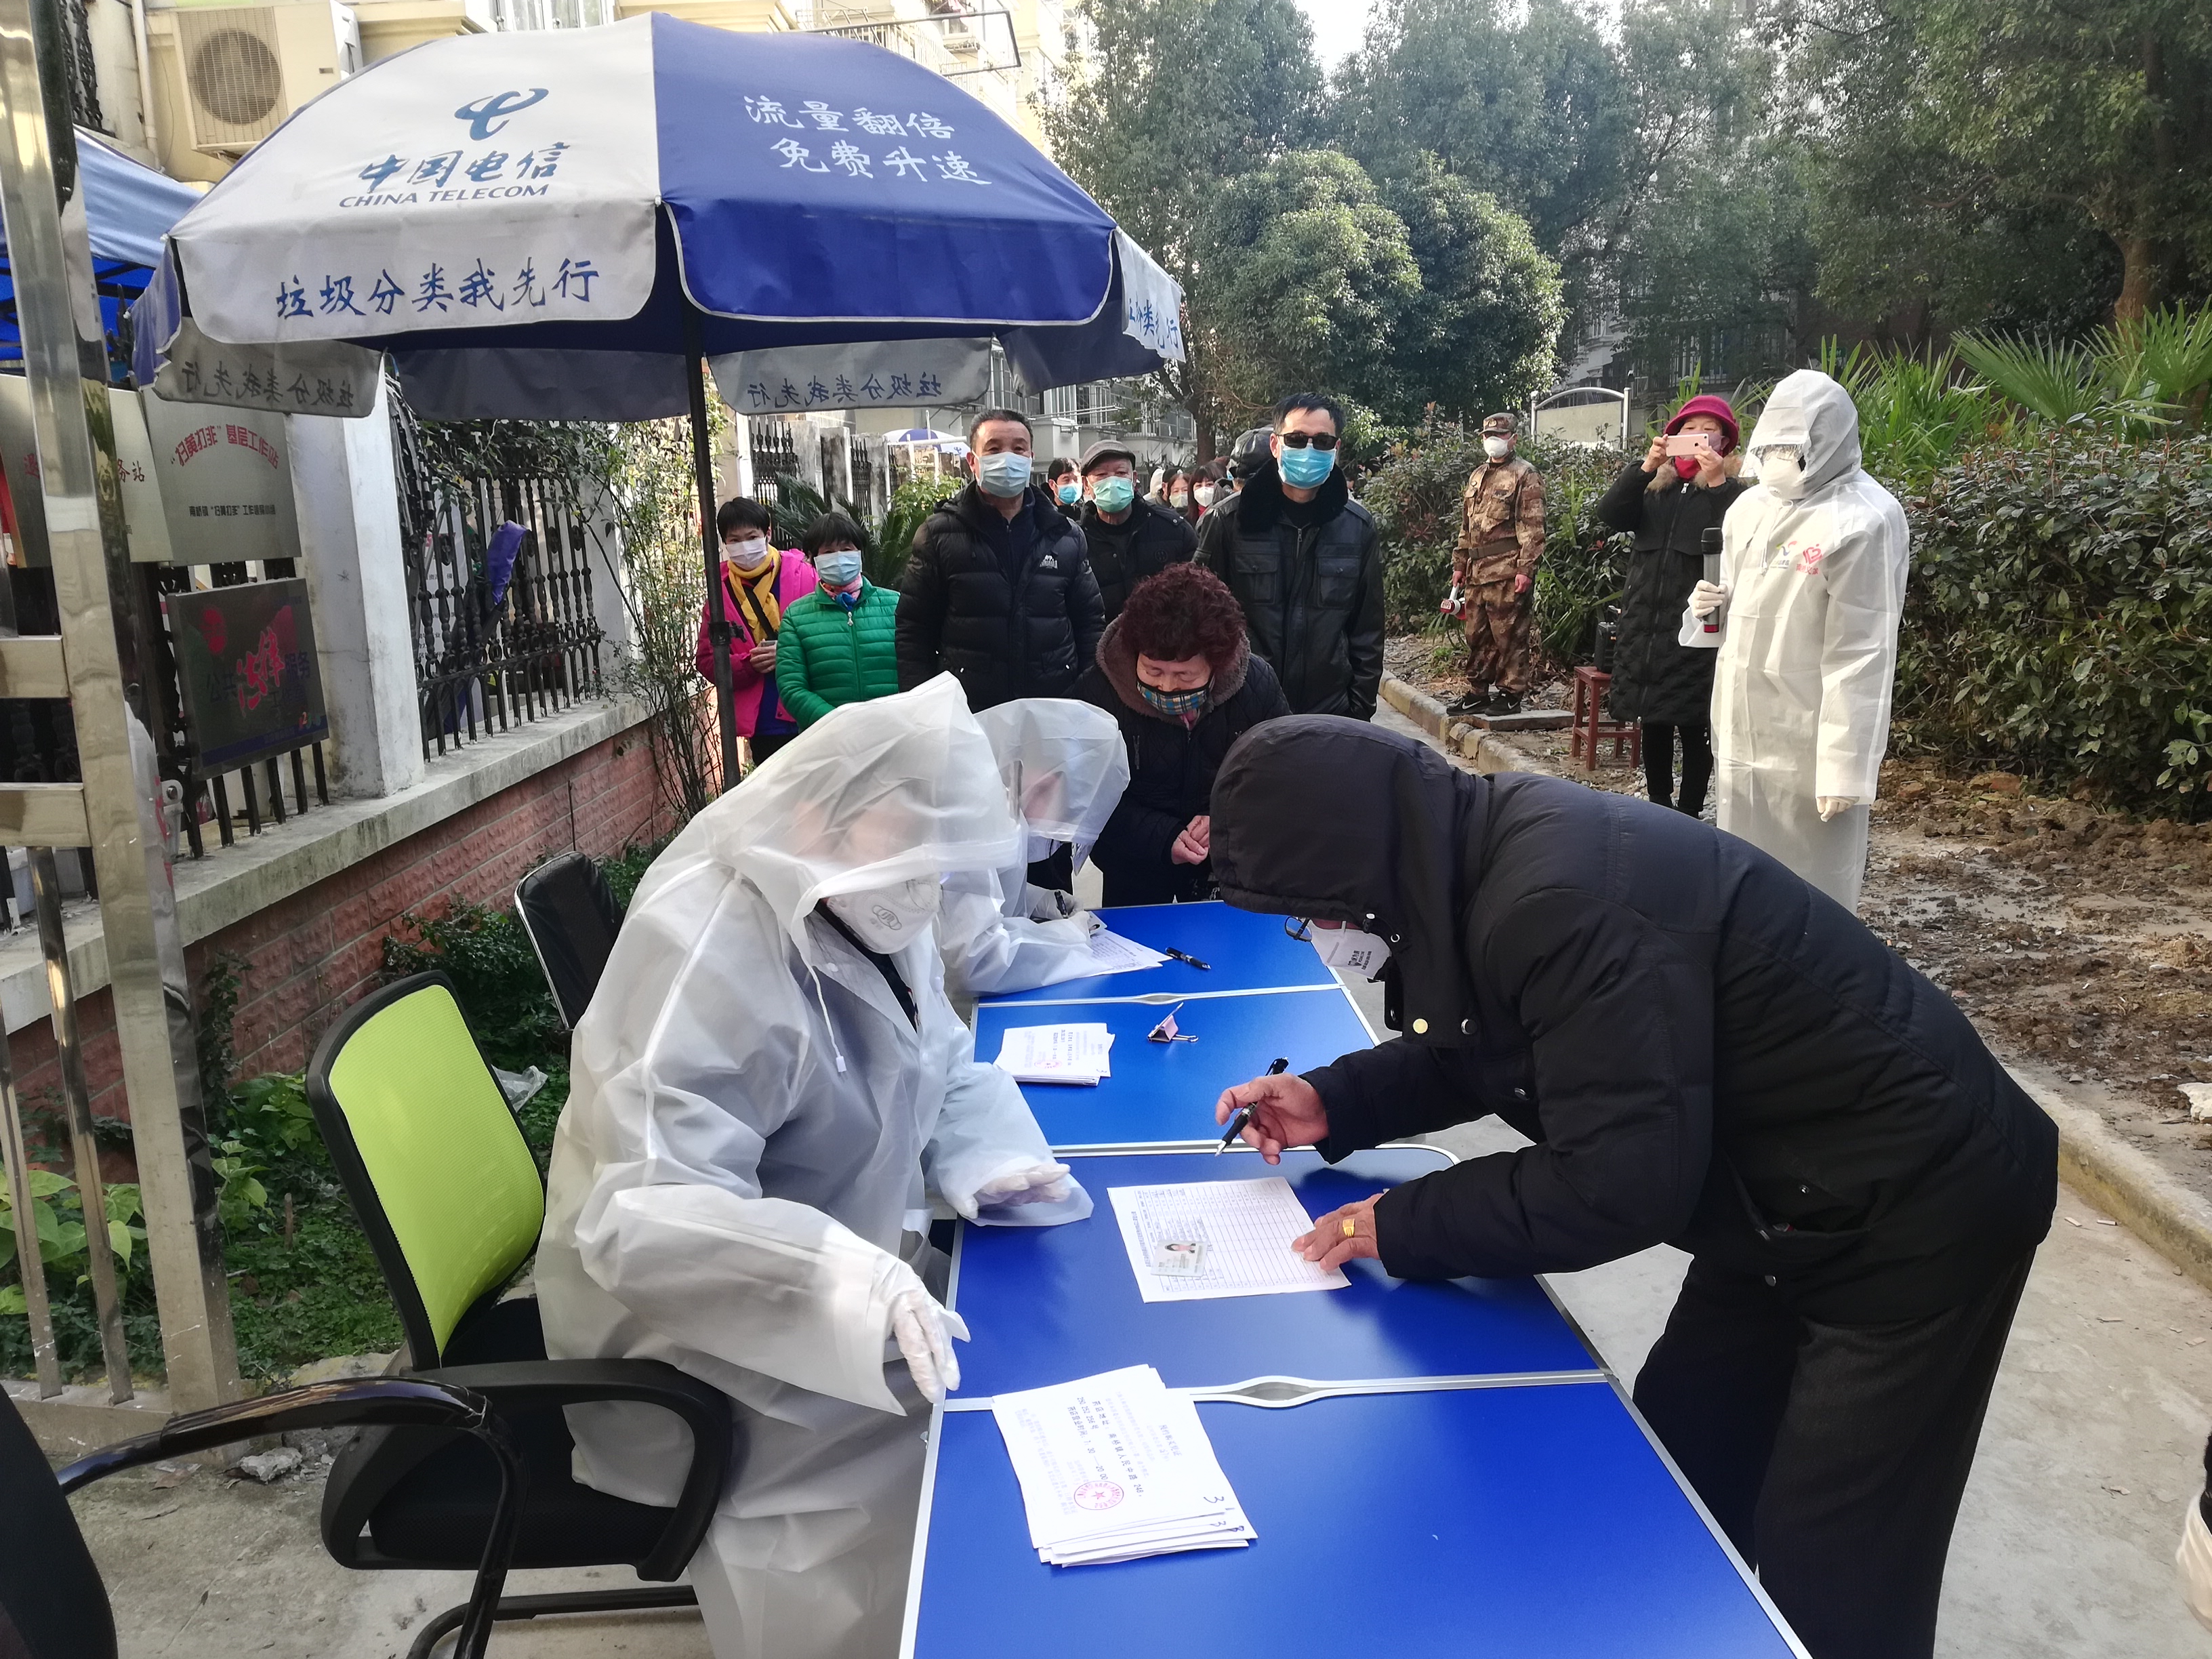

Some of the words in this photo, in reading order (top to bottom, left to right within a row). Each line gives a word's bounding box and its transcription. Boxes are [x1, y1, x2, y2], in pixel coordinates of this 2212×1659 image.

[744, 96, 955, 140] 流量翻倍
[358, 141, 571, 193] 中国电信
[771, 138, 992, 184] 免费升速
[339, 192, 417, 208] CHINA
[428, 184, 548, 203] TELECOM
[275, 256, 599, 320] 垃圾分类我先行
